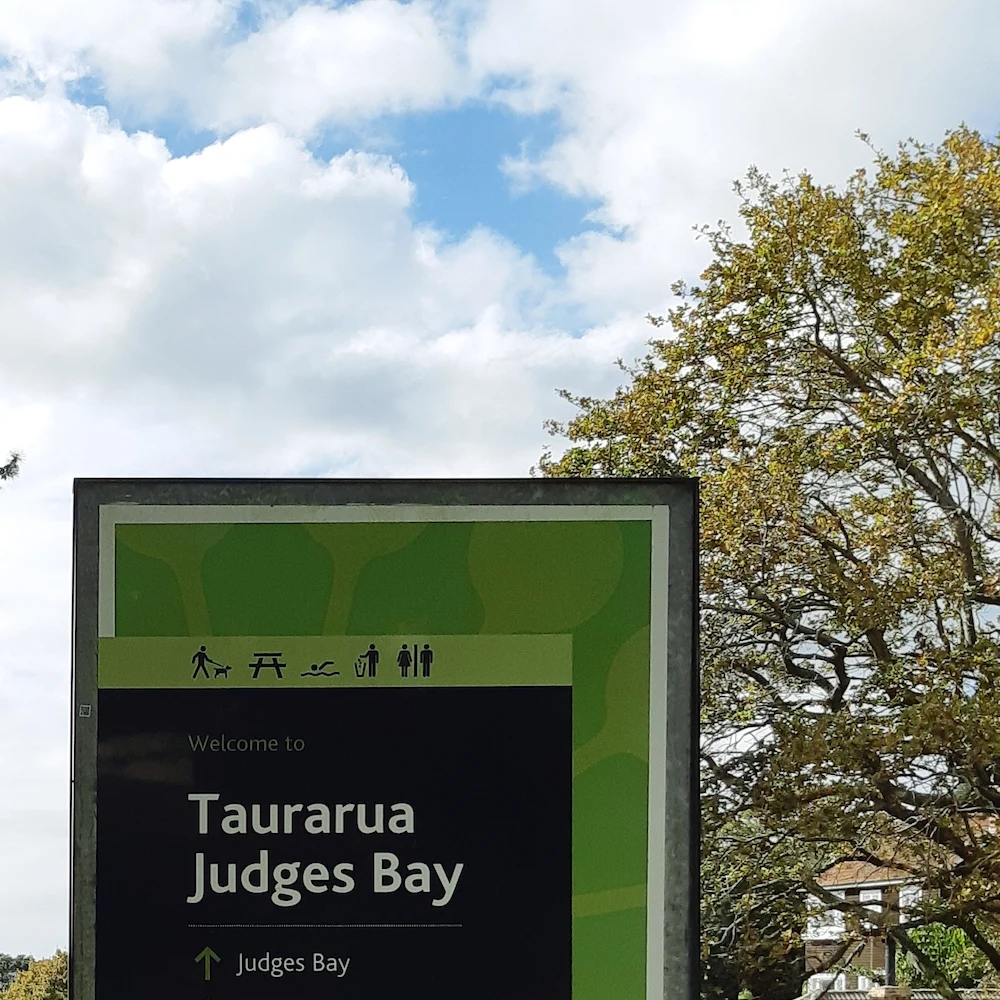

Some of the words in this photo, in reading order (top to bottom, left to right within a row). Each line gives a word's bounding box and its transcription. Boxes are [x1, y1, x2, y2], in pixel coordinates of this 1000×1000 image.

[187, 734, 279, 752] Welcome
[284, 736, 305, 752] to
[187, 793, 415, 835] Taurarua
[186, 849, 355, 907] Judges
[373, 852, 464, 907] Bay
[235, 951, 305, 978] Judges
[313, 952, 351, 978] Bay
